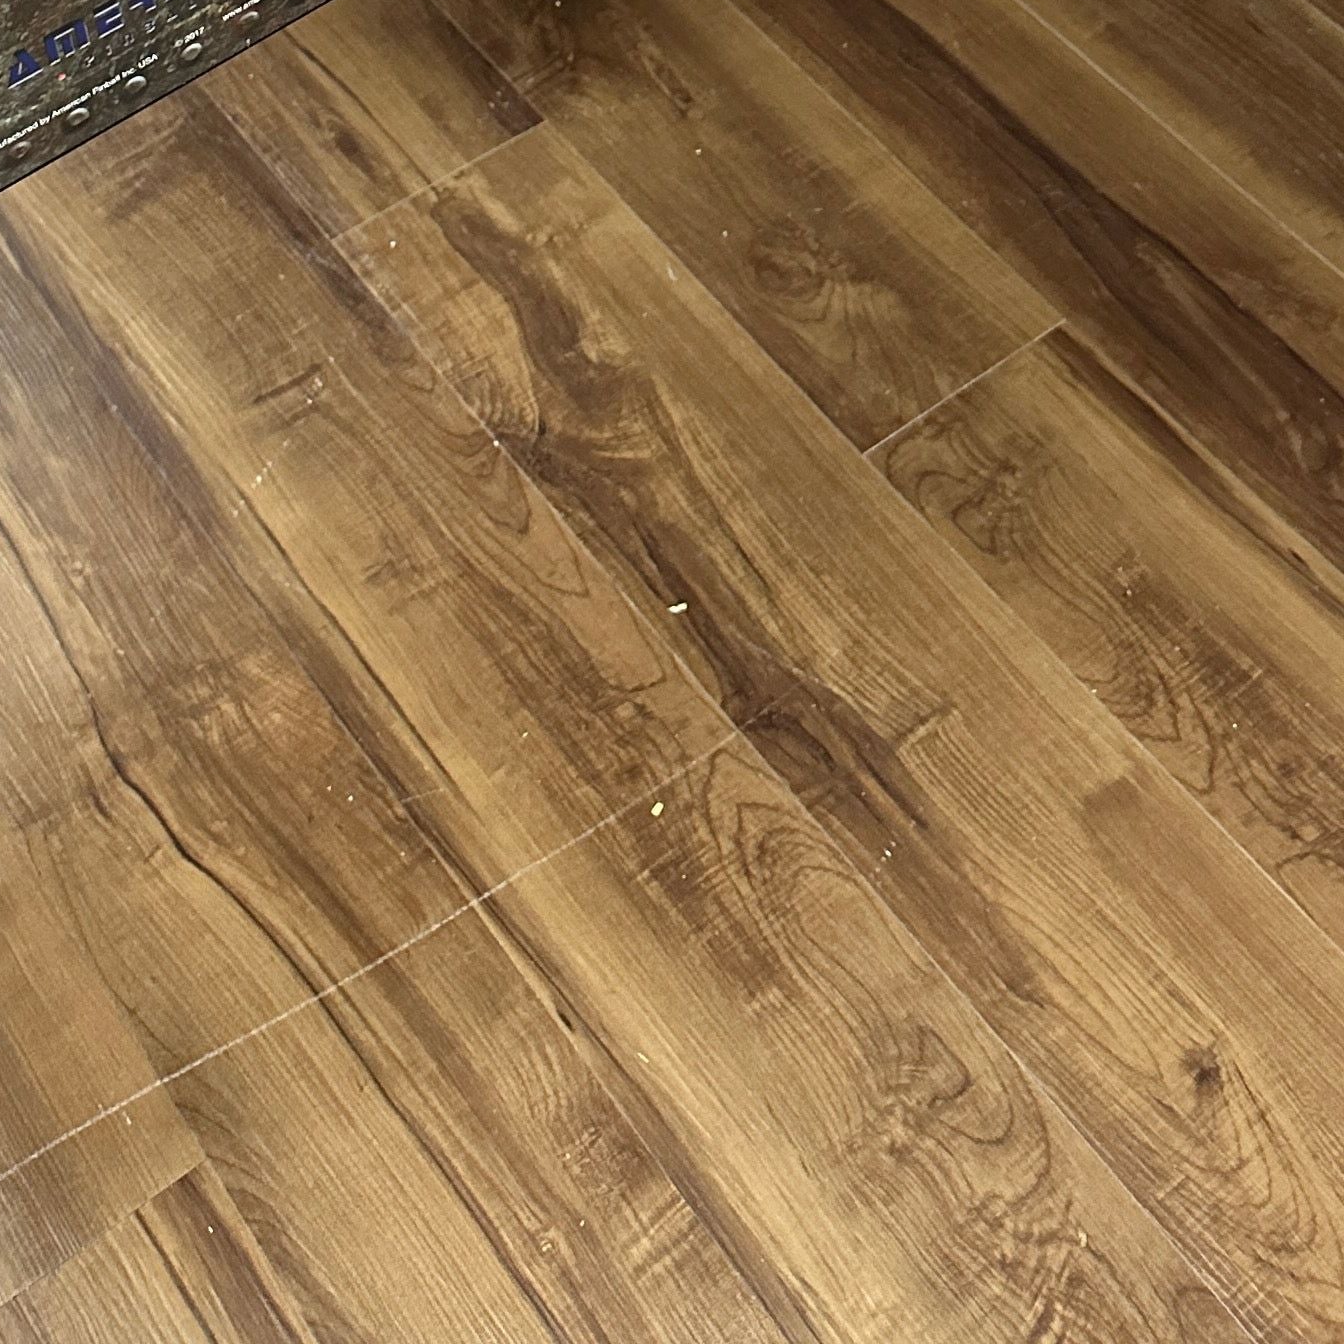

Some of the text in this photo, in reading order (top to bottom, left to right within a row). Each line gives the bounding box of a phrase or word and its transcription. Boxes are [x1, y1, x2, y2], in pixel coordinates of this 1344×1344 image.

[38, 114, 52, 127] by
[51, 91, 92, 120] American
[91, 73, 122, 96] Pinball
[137, 53, 159, 70] USA
[183, 26, 207, 44] 2017
